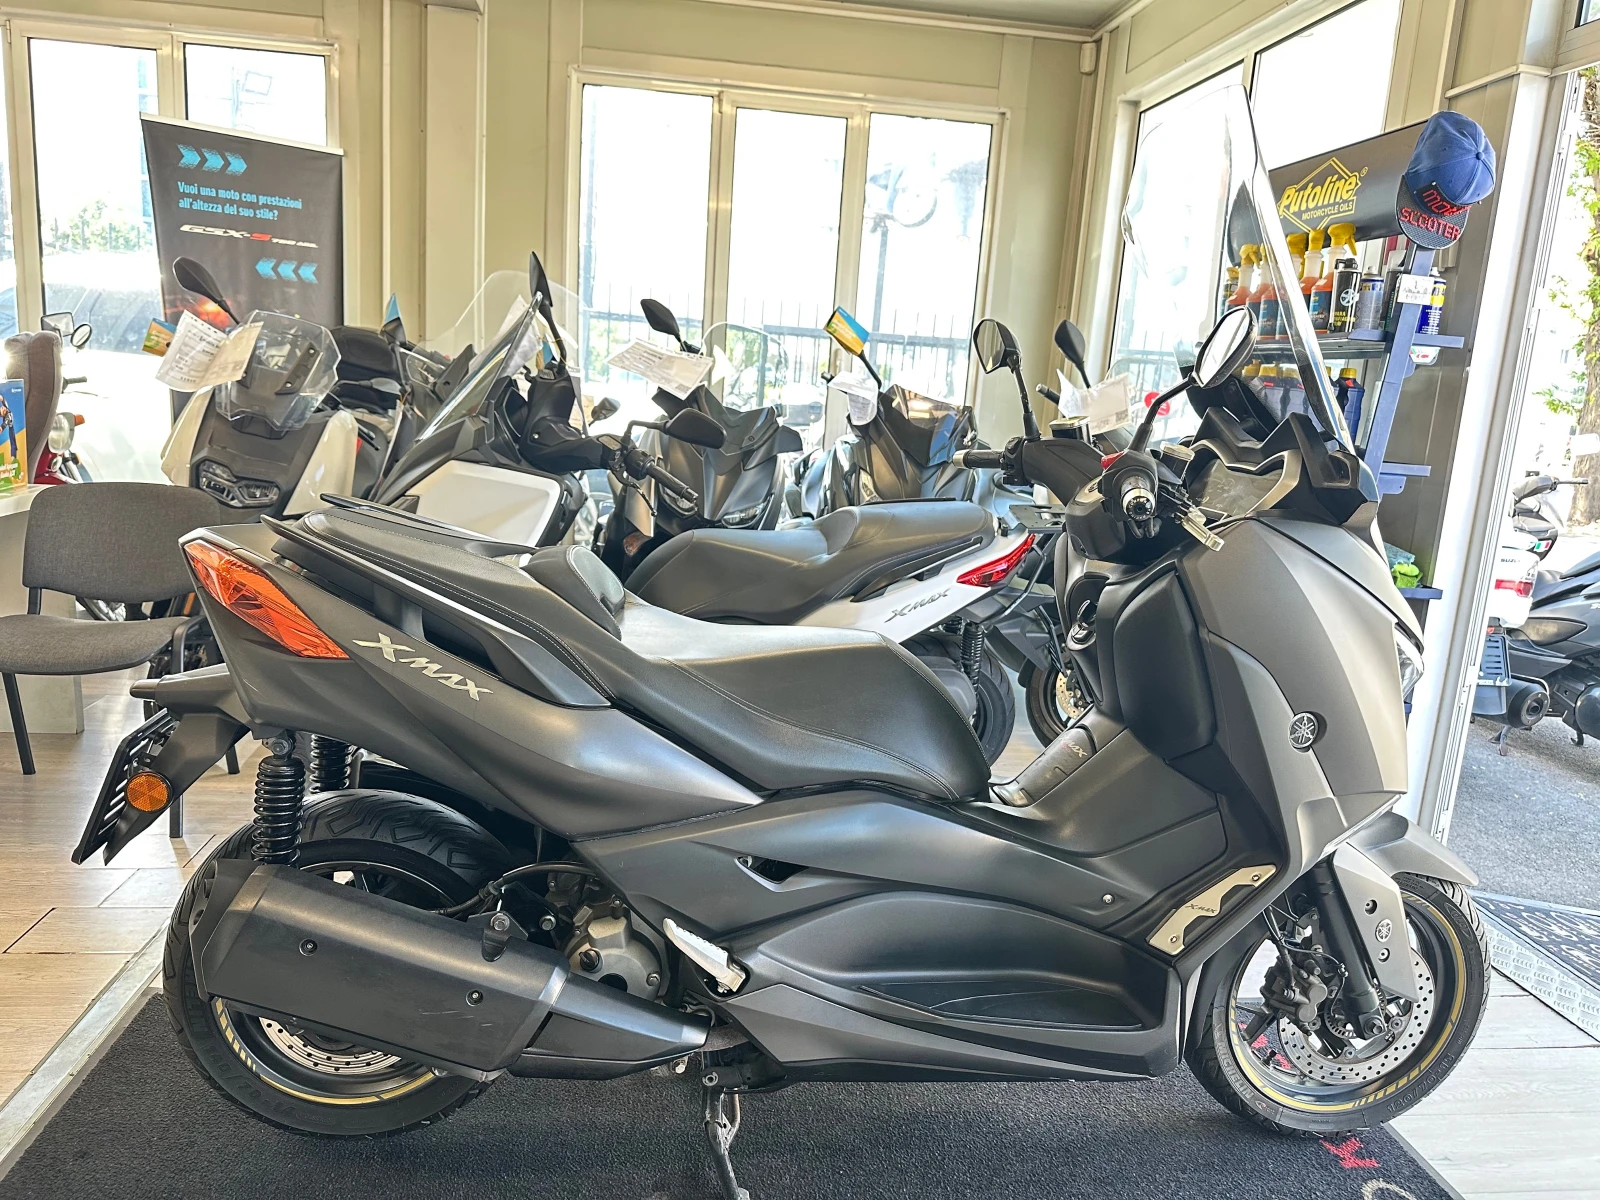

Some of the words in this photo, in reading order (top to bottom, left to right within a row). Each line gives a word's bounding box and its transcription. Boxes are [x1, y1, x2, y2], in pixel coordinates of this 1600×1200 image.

[177, 181, 198, 194] Vuoi
[200, 186, 216, 197] una
[218, 189, 239, 200] moto
[241, 192, 257, 203] con
[258, 194, 302, 210] prestazioni
[178, 198, 223, 213] all'altezza
[224, 204, 238, 215] del
[239, 207, 255, 217] suo
[256, 209, 279, 220] stile?
[1279, 174, 1358, 217] Putoline
[1301, 205, 1339, 220] MOTORCYCLE
[1339, 201, 1353, 211] OILS
[1400, 206, 1461, 241] SCOOTER
[1216, 1040, 1256, 1100] MICHELIN
